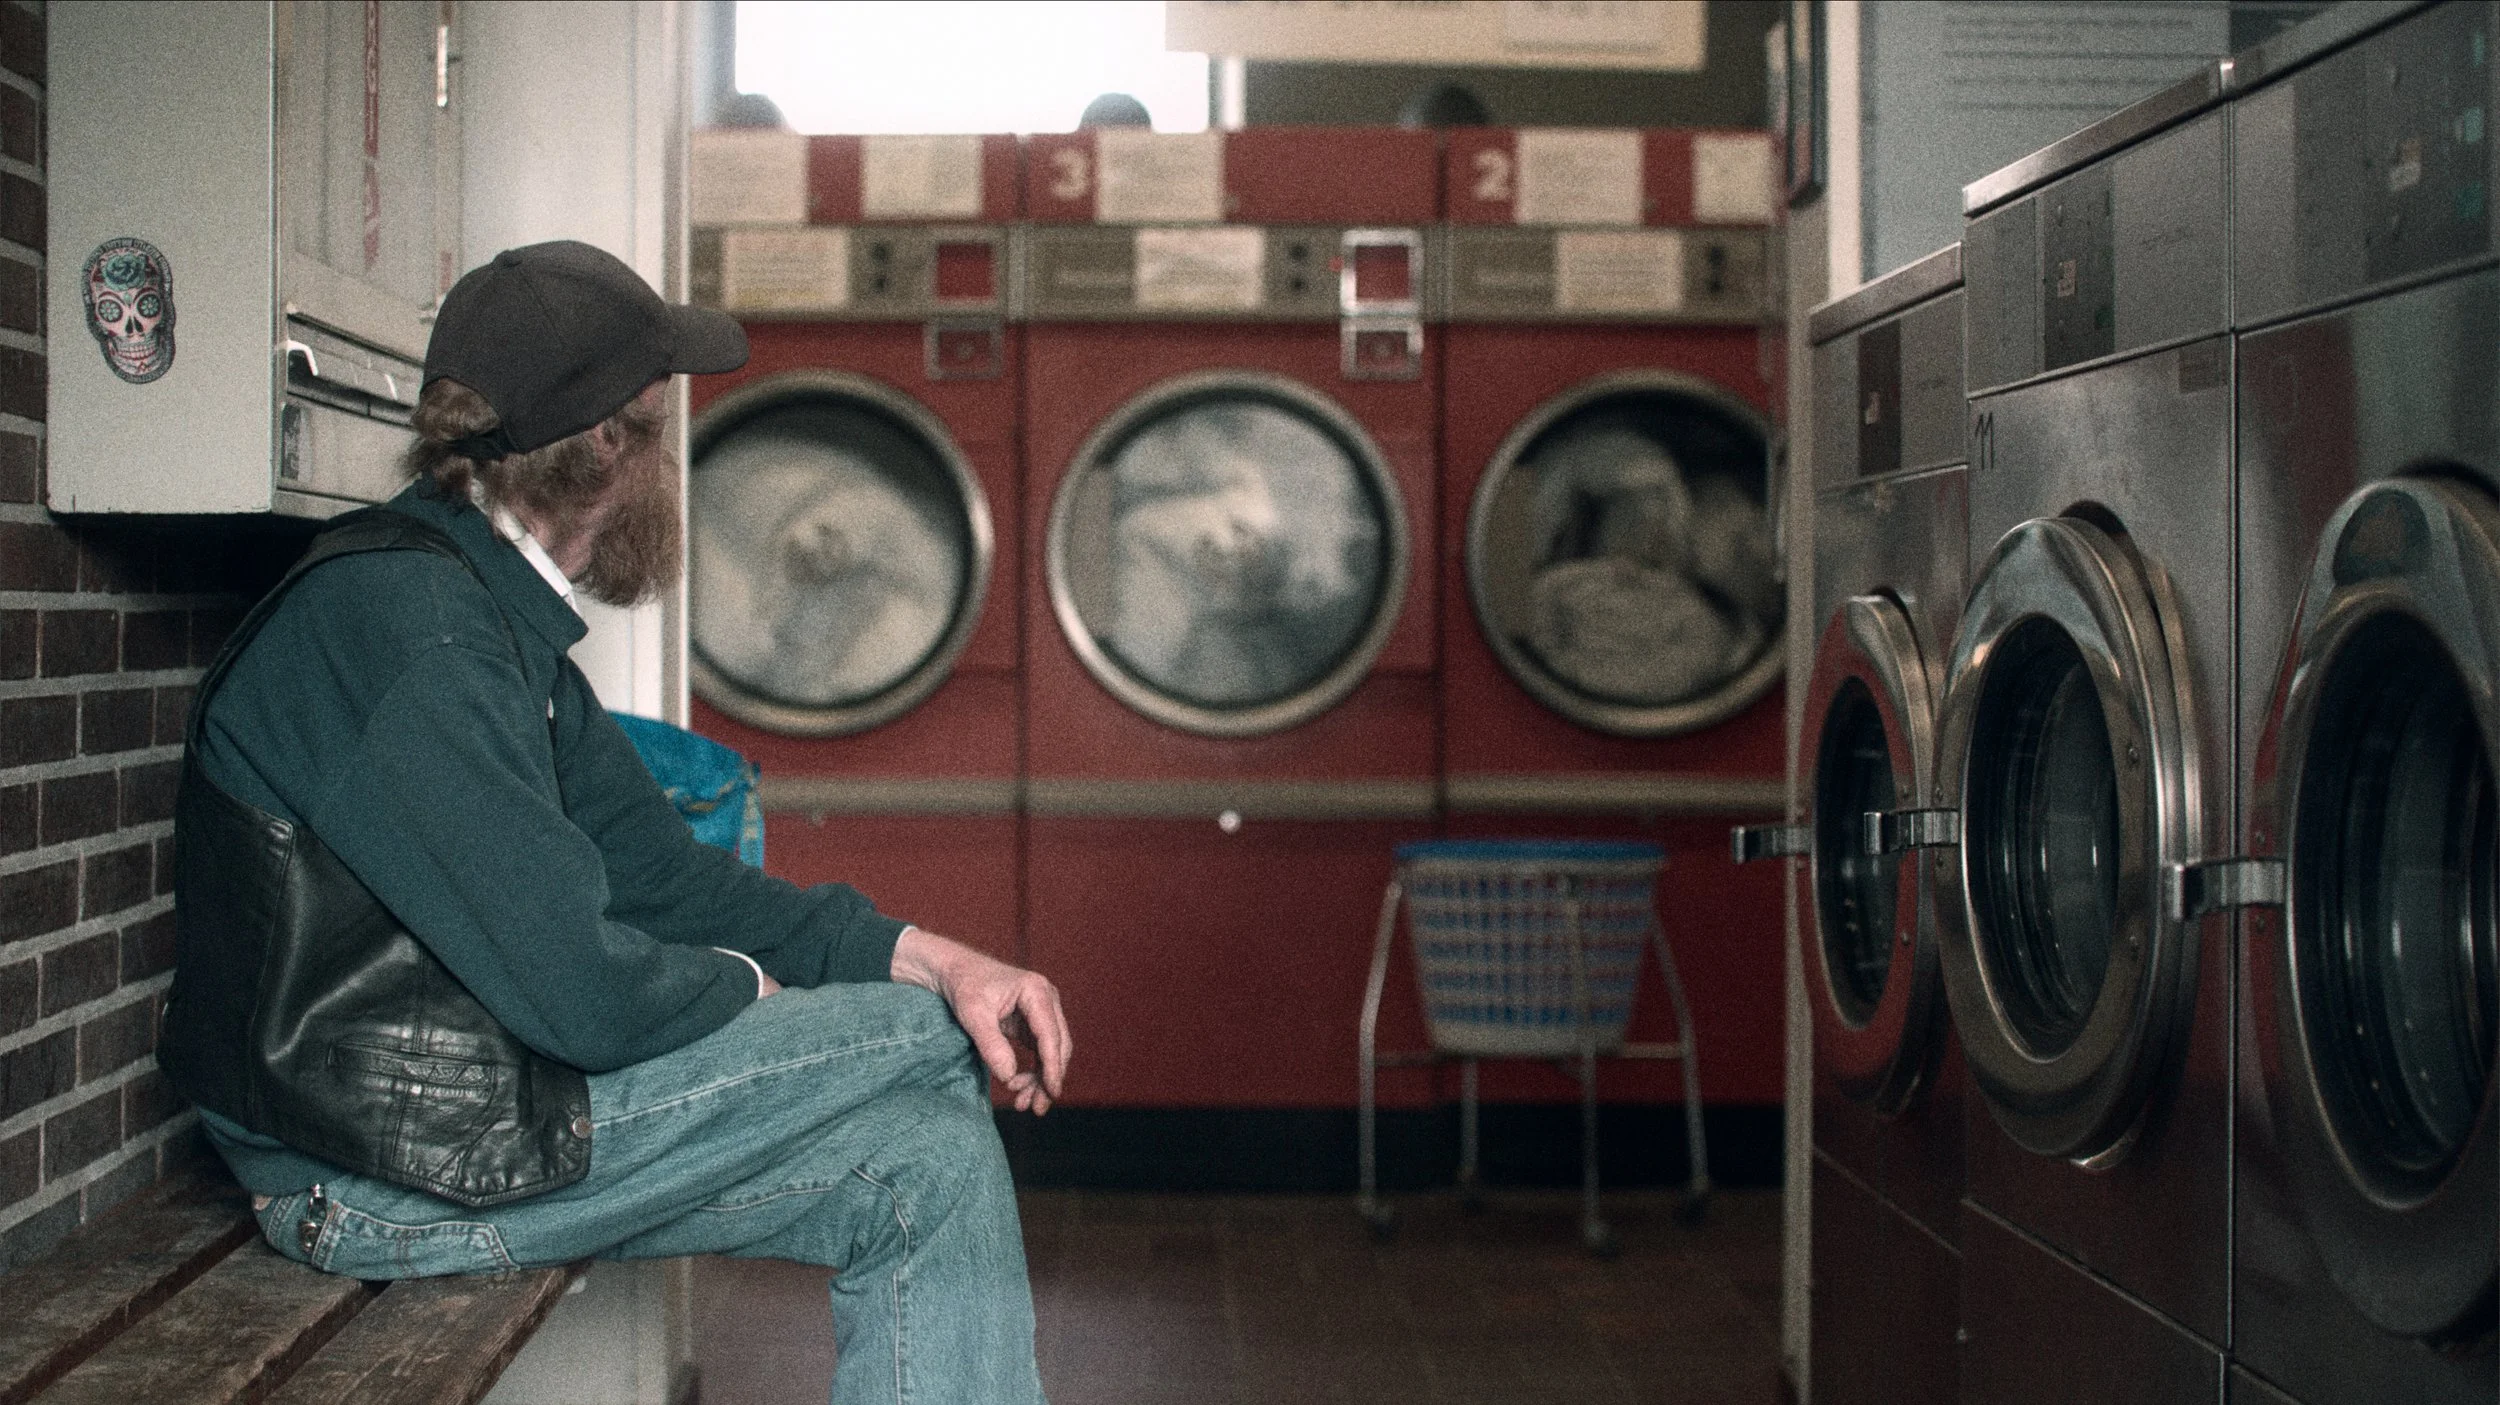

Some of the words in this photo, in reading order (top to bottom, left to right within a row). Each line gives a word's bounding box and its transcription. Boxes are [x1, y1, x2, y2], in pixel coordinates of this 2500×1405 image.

[1053, 149, 1087, 198] 3
[1474, 150, 1508, 199] 2
[1974, 412, 1995, 470] 11
